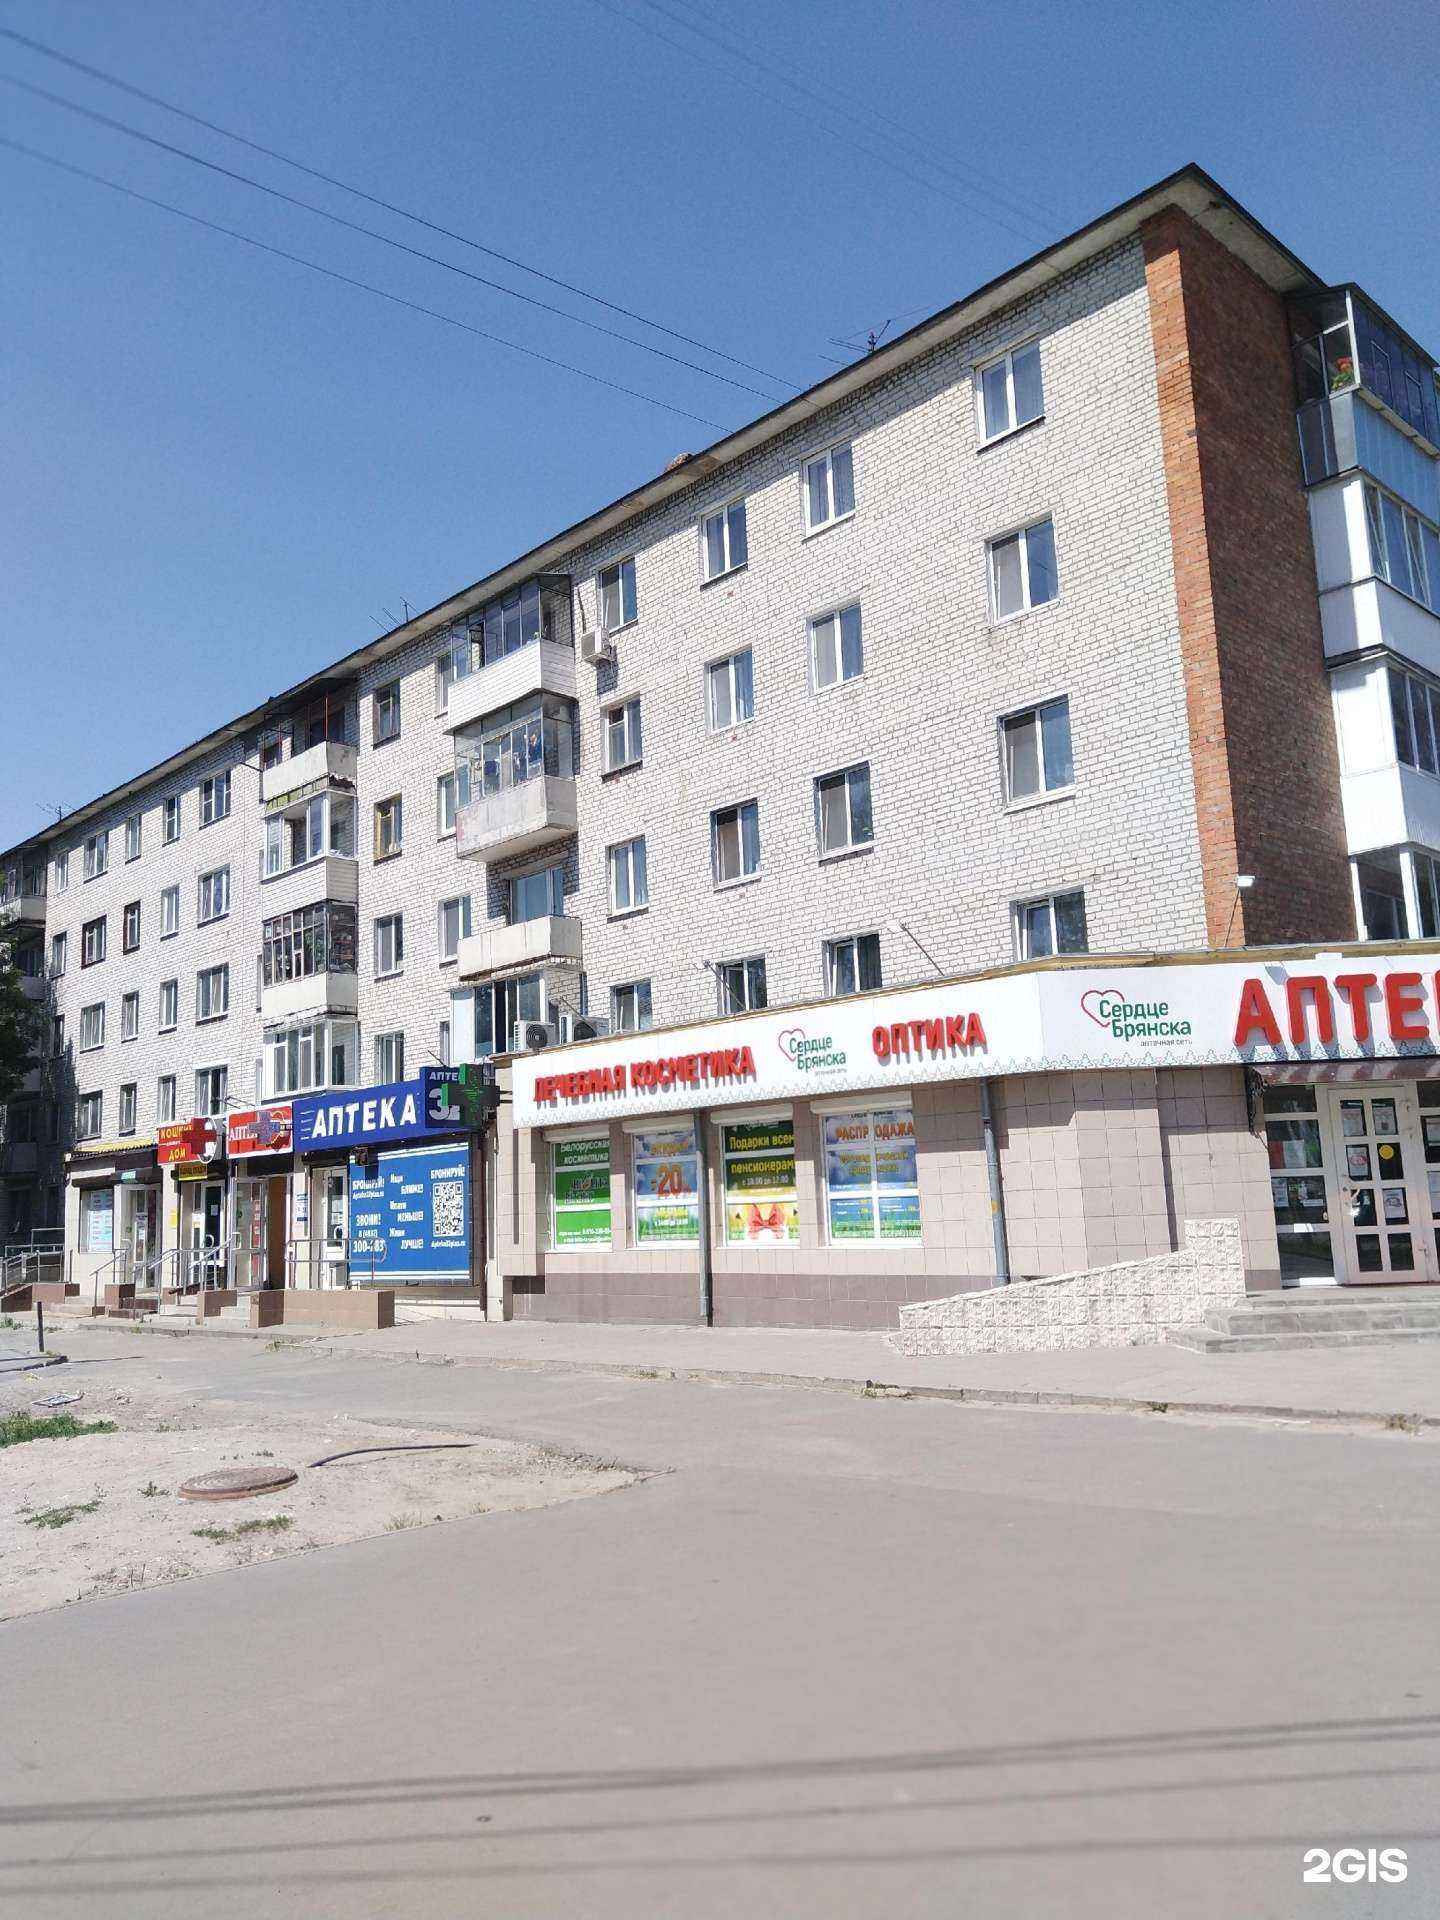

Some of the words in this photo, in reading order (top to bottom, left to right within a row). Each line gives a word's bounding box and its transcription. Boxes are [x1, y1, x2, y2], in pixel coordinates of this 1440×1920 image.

[1099, 1000, 1169, 1021] Сердце
[1234, 973, 1440, 1047] АПТЕ
[872, 1012, 988, 1058] ОПТИКА
[1111, 1018, 1192, 1041] Брянска
[789, 1036, 833, 1055] Сердце
[797, 1050, 847, 1074] Брянска
[429, 1071, 465, 1082] АПТЕ
[534, 1064, 627, 1103] ЛЕЧЕБНАЯ
[630, 1046, 756, 1088] КОСМЕТИКА
[311, 1093, 417, 1139] АПТЕКА
[168, 1147, 186, 1161] ДОМ
[729, 1135, 770, 1151] Подарки
